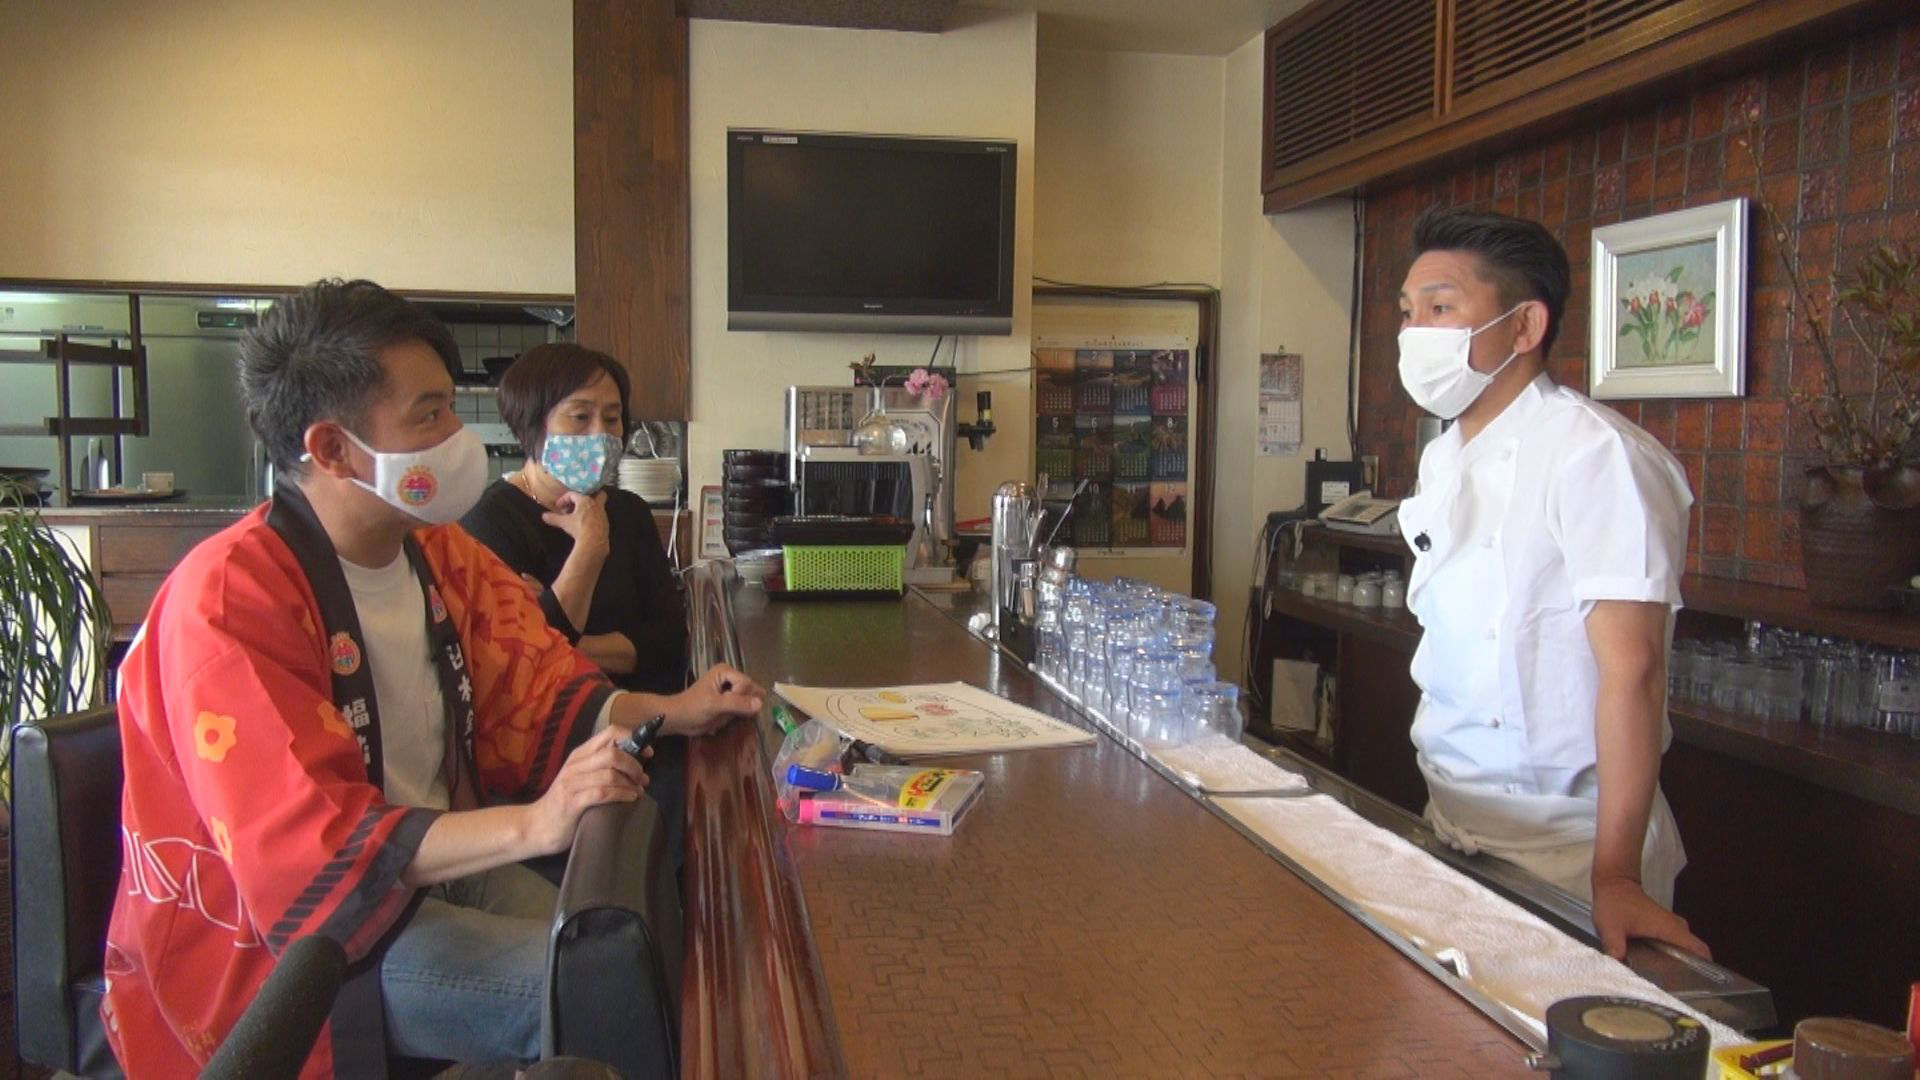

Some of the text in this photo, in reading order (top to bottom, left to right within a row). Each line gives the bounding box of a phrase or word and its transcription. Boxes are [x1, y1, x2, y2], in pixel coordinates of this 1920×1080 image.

[1052, 417, 1059, 428] 5
[1167, 417, 1174, 429] 8
[1088, 483, 1100, 495] 10
[1127, 483, 1136, 494] 11
